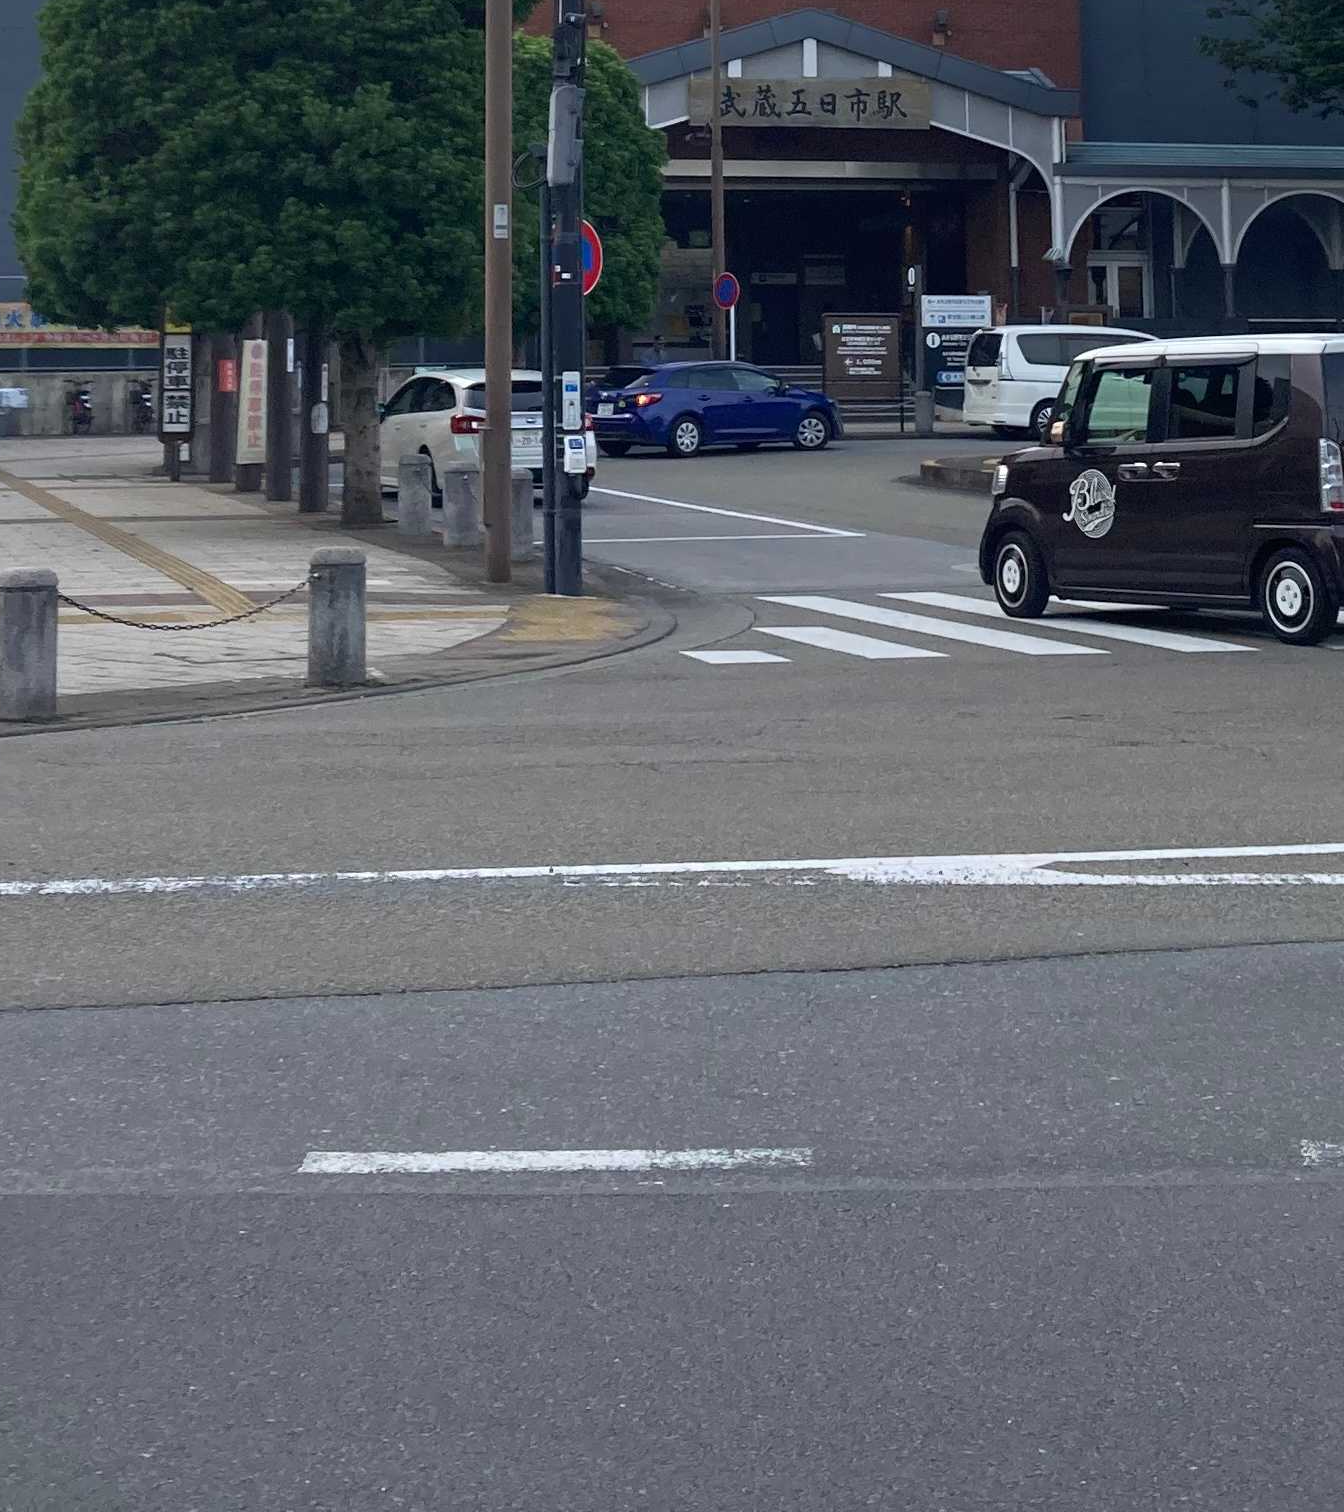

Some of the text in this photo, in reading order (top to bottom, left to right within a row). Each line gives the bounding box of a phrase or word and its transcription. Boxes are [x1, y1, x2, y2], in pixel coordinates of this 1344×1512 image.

[720, 84, 908, 122] 武蔵五日市駅
